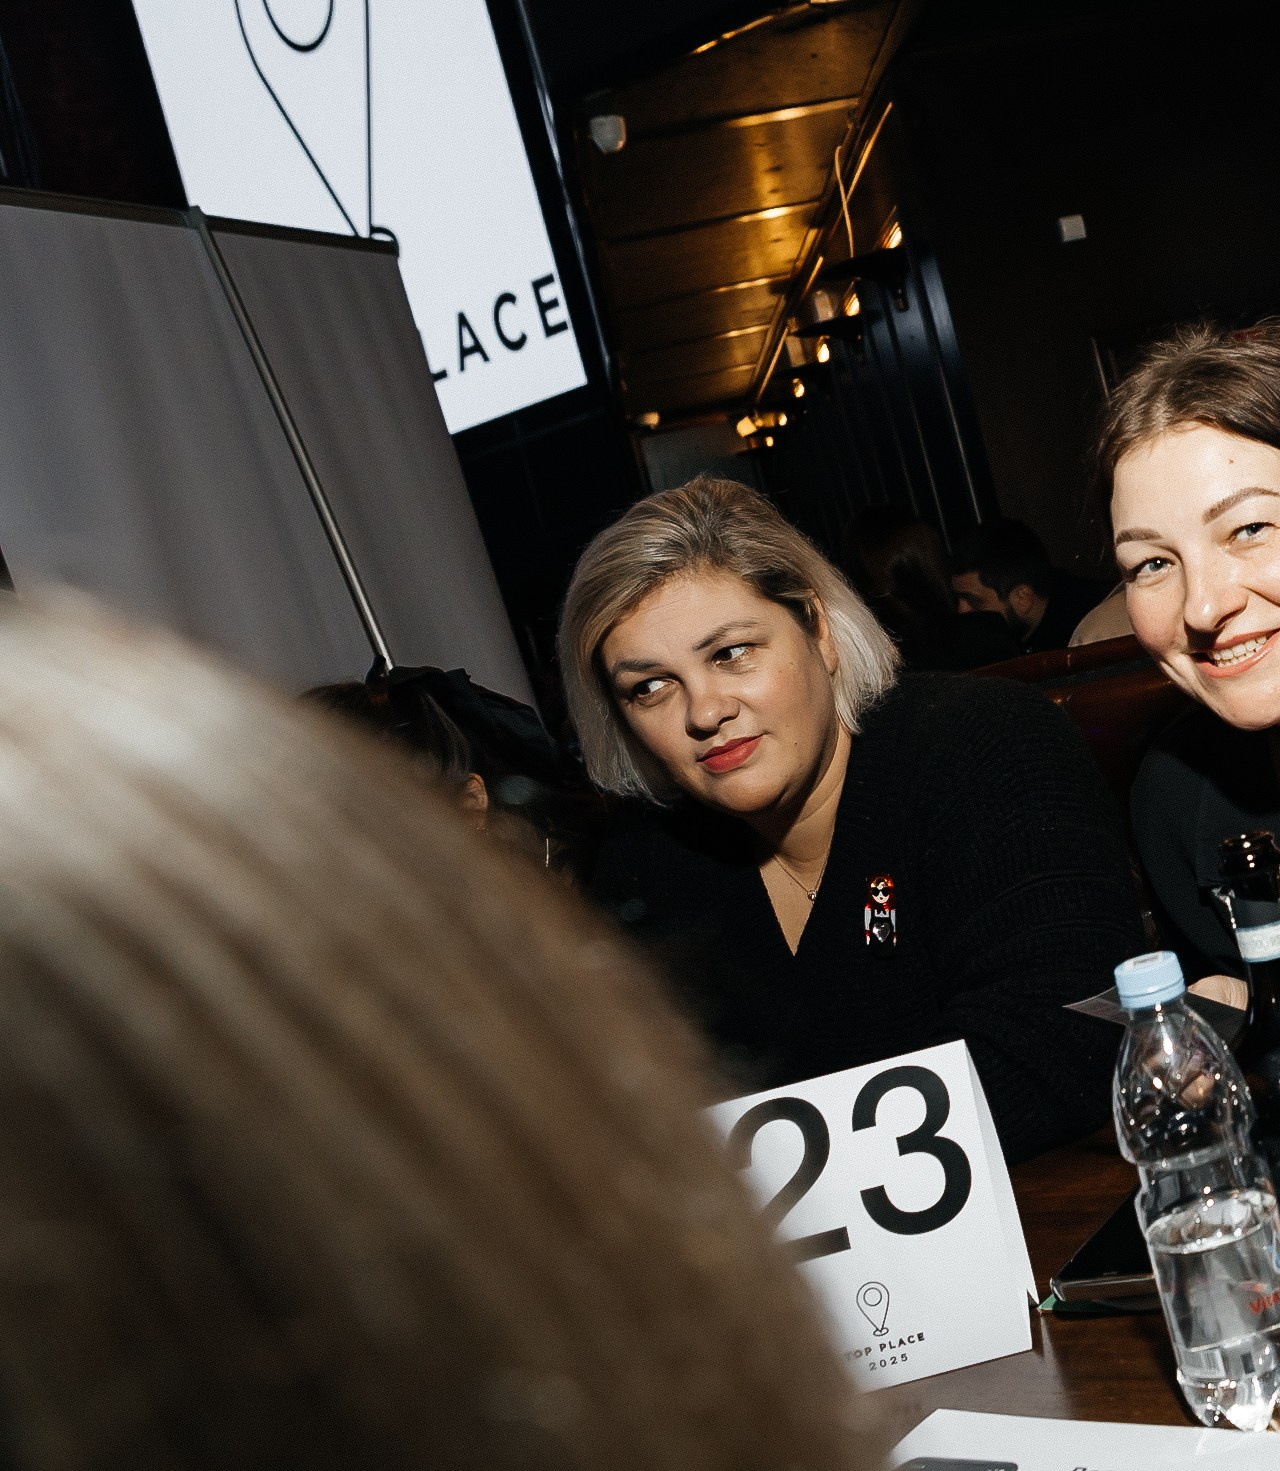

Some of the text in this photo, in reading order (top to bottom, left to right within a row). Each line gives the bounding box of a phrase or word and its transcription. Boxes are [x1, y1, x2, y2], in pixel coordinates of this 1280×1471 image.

[432, 273, 569, 382] ACE
[725, 1065, 972, 1264] 23
[869, 1353, 908, 1371] 2025
[879, 1332, 925, 1352] PLACE
